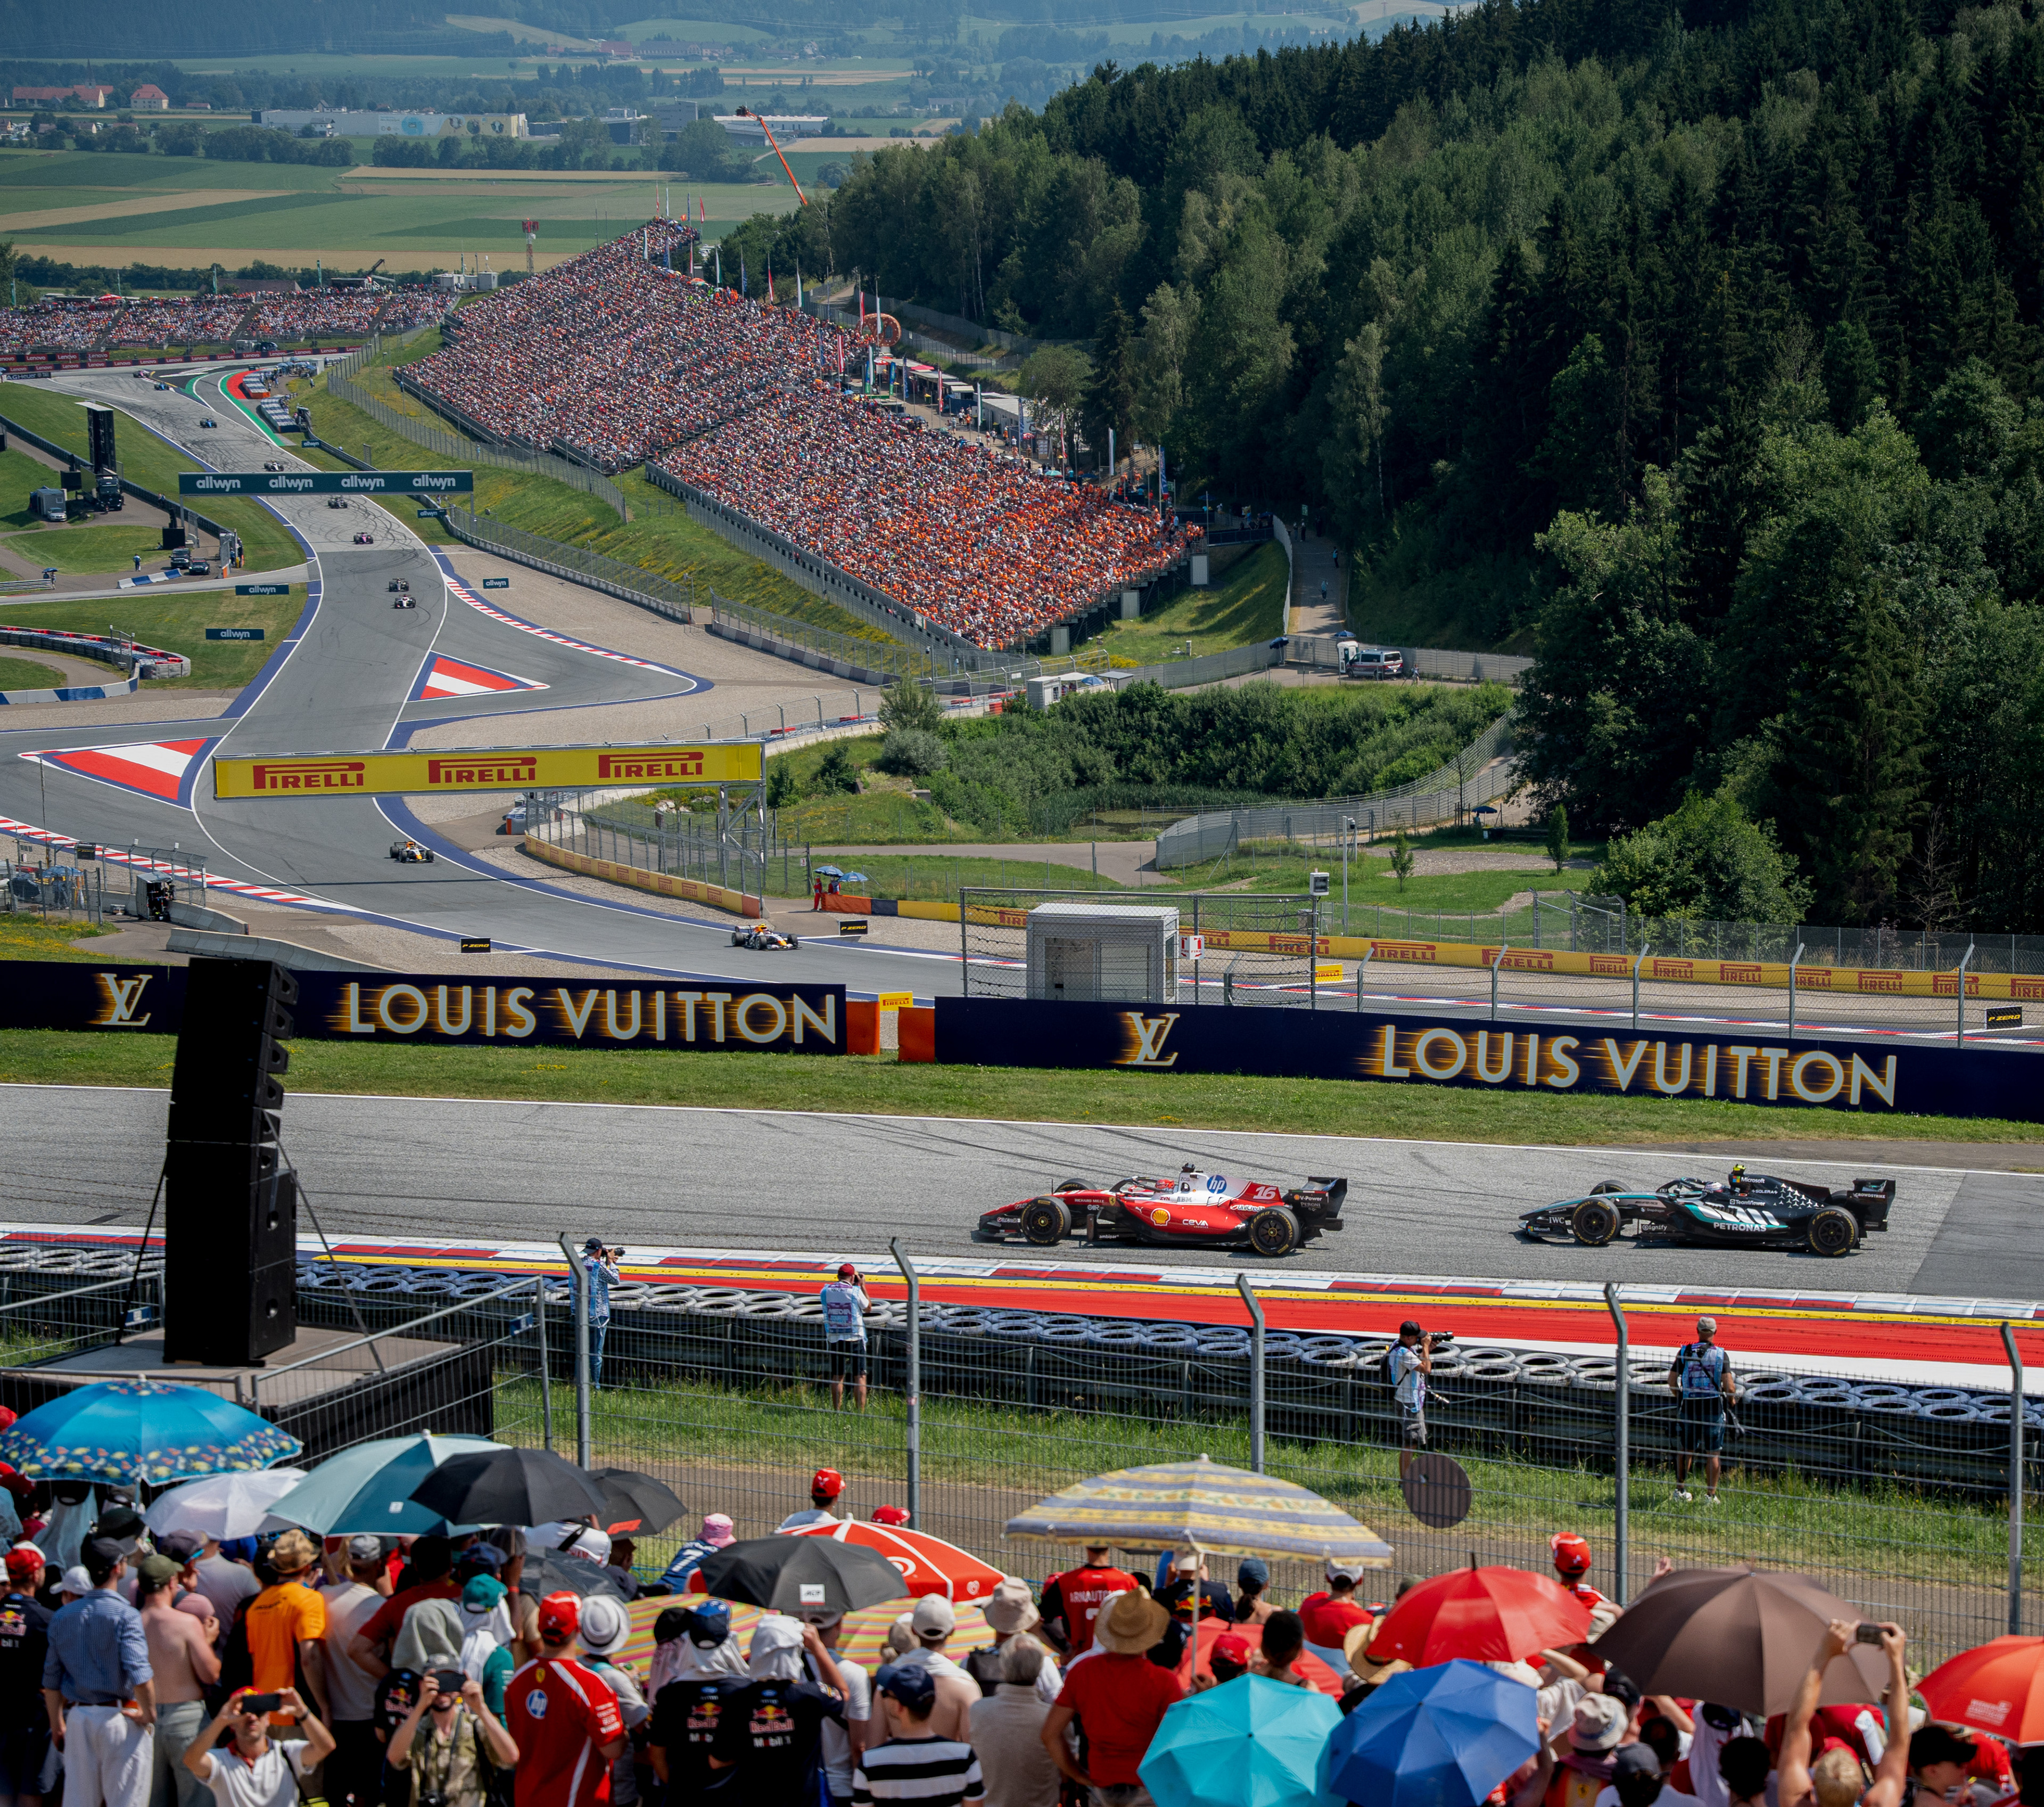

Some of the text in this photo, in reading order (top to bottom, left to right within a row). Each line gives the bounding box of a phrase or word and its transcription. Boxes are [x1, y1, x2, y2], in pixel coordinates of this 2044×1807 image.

[196, 476, 241, 492] allwyn
[269, 476, 313, 491] allwyn
[341, 475, 384, 490] allwyn
[413, 475, 456, 490] allwyn
[249, 585, 276, 595] allwyn
[220, 629, 250, 639] allwyn
[428, 756, 537, 783] PIRELLI
[599, 752, 704, 778] PIRELLI
[253, 762, 365, 789] PIRELLI
[682, 882, 698, 897] PIRELLI
[707, 887, 722, 903] PIRELLI
[1371, 942, 1436, 961] PIRELLI
[1590, 955, 1628, 974] PIRELLI
[1653, 960, 1694, 979] PIRELLI
[1720, 963, 1762, 983] PIRELLI
[1858, 972, 1903, 991] PIRELLI
[1933, 975, 1979, 995] PIRELI
[883, 997, 909, 1006] PIRELLI
[350, 983, 836, 1044] LOUIS VUITTON
[1383, 1025, 1897, 1107] LOUIS VUITTON
[1208, 1175, 1225, 1194] hp
[1253, 1186, 1277, 1200] 16
[1713, 1222, 1767, 1232] PETRONAS
[672, 1549, 704, 1572] 7
